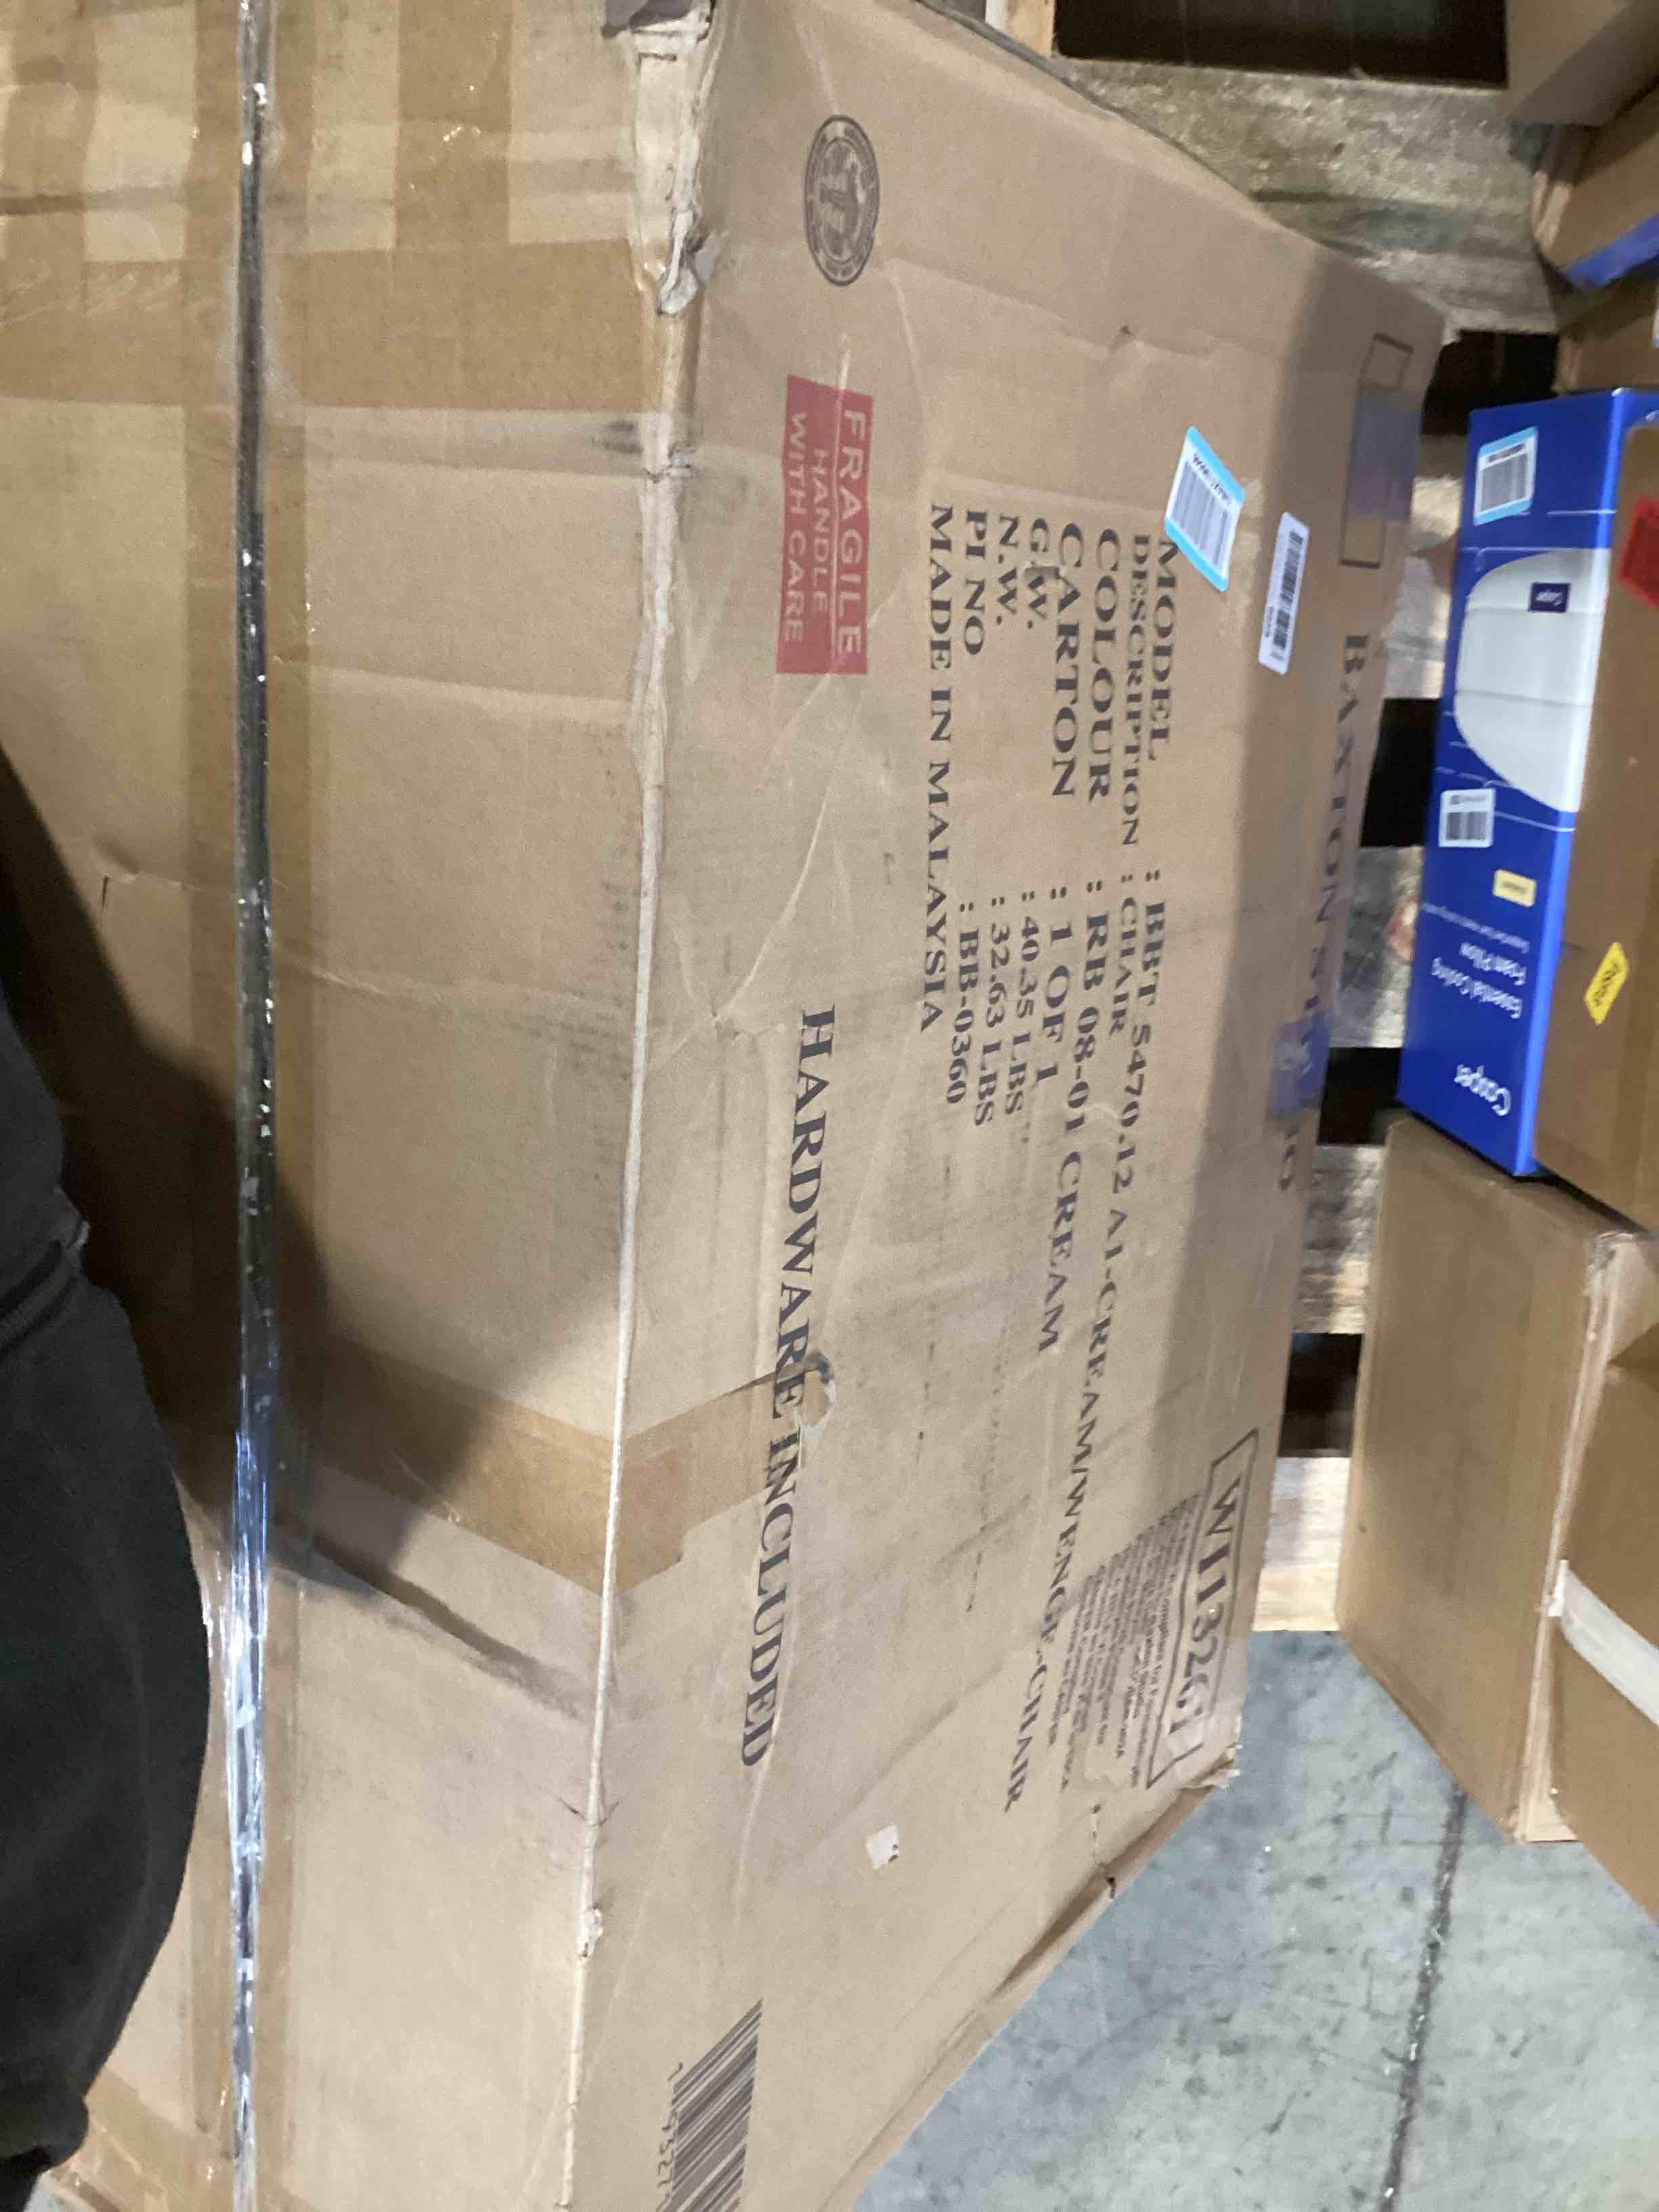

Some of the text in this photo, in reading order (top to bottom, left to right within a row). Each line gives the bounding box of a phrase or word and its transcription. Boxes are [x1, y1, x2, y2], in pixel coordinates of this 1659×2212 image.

[783, 411, 806, 645] WITH CARE
[811, 447, 829, 614] HANDLE
[836, 409, 865, 655] FRAGILE
[964, 508, 987, 560] PI
[994, 513, 1019, 625] N.W.
[962, 578, 985, 655] NO
[1050, 522, 1084, 798] CARTON
[1088, 528, 1120, 803] COLOUR
[1147, 540, 1178, 761] MODEL
[1121, 533, 1150, 846] DESCRIPTION
[920, 504, 953, 1034] MADE IN MALAYSIA
[985, 923, 1009, 1028] 32.63
[1016, 916, 1038, 1019] 40.35
[1049, 922, 1072, 945] 1
[1083, 914, 1107, 991] RB
[1109, 897, 1136, 1036] CHAIR
[1136, 901, 1165, 1006] BBT
[945, 928, 979, 1105] BB-0360
[1041, 965, 1069, 1043] OF
[1065, 1006, 1099, 1132] 08-01
[974, 1040, 1002, 1126] LBS
[1004, 1032, 1030, 1115] LBS
[1034, 1062, 1058, 1086] 1
[1113, 1024, 1150, 1193] 5470.12
[1037, 1151, 1081, 1355] CREAM
[741, 1004, 835, 1767] HARDWARE INCLUDED
